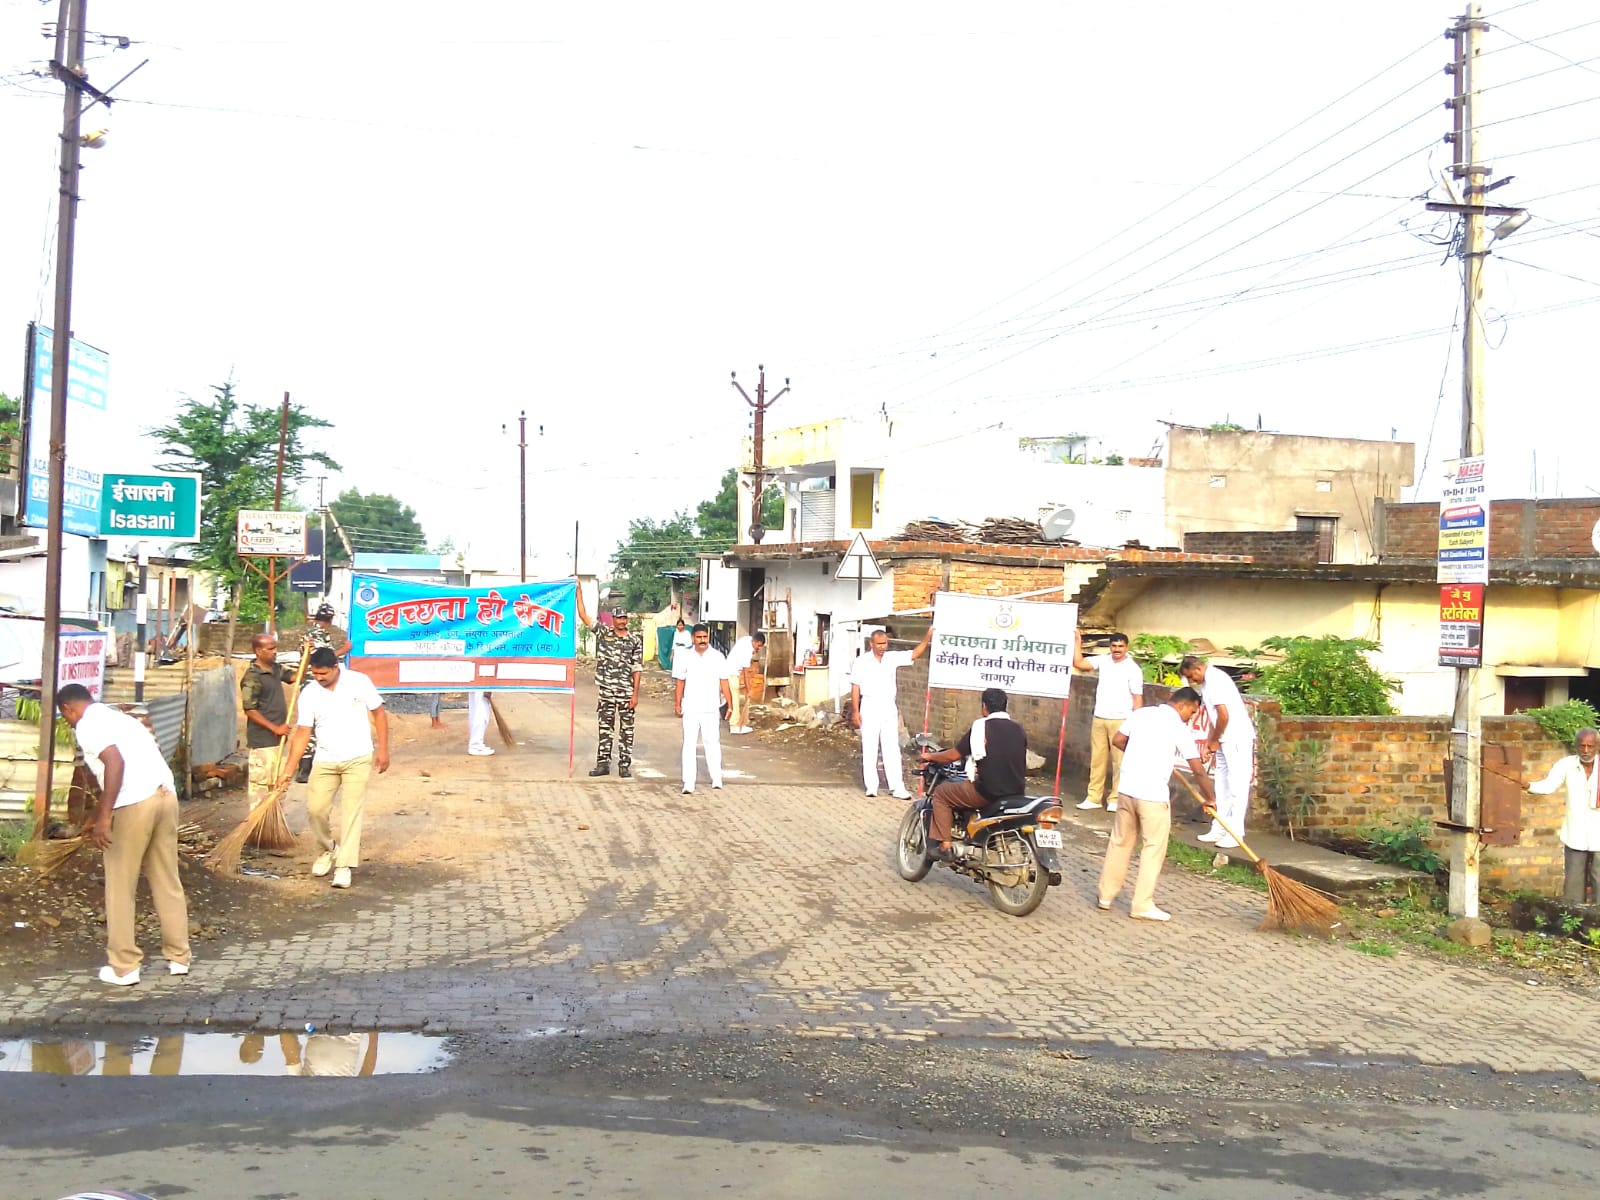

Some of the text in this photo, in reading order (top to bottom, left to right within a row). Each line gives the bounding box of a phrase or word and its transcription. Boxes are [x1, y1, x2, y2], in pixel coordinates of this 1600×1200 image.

[111, 479, 175, 503] ईसासनी
[110, 509, 175, 530] Isasani
[366, 590, 566, 637] स्वच्छता ही सेवा
[940, 633, 1068, 656] स्वच्छता अभियान
[1007, 657, 1046, 673] पोलीस
[980, 673, 1016, 687] नागपूर
